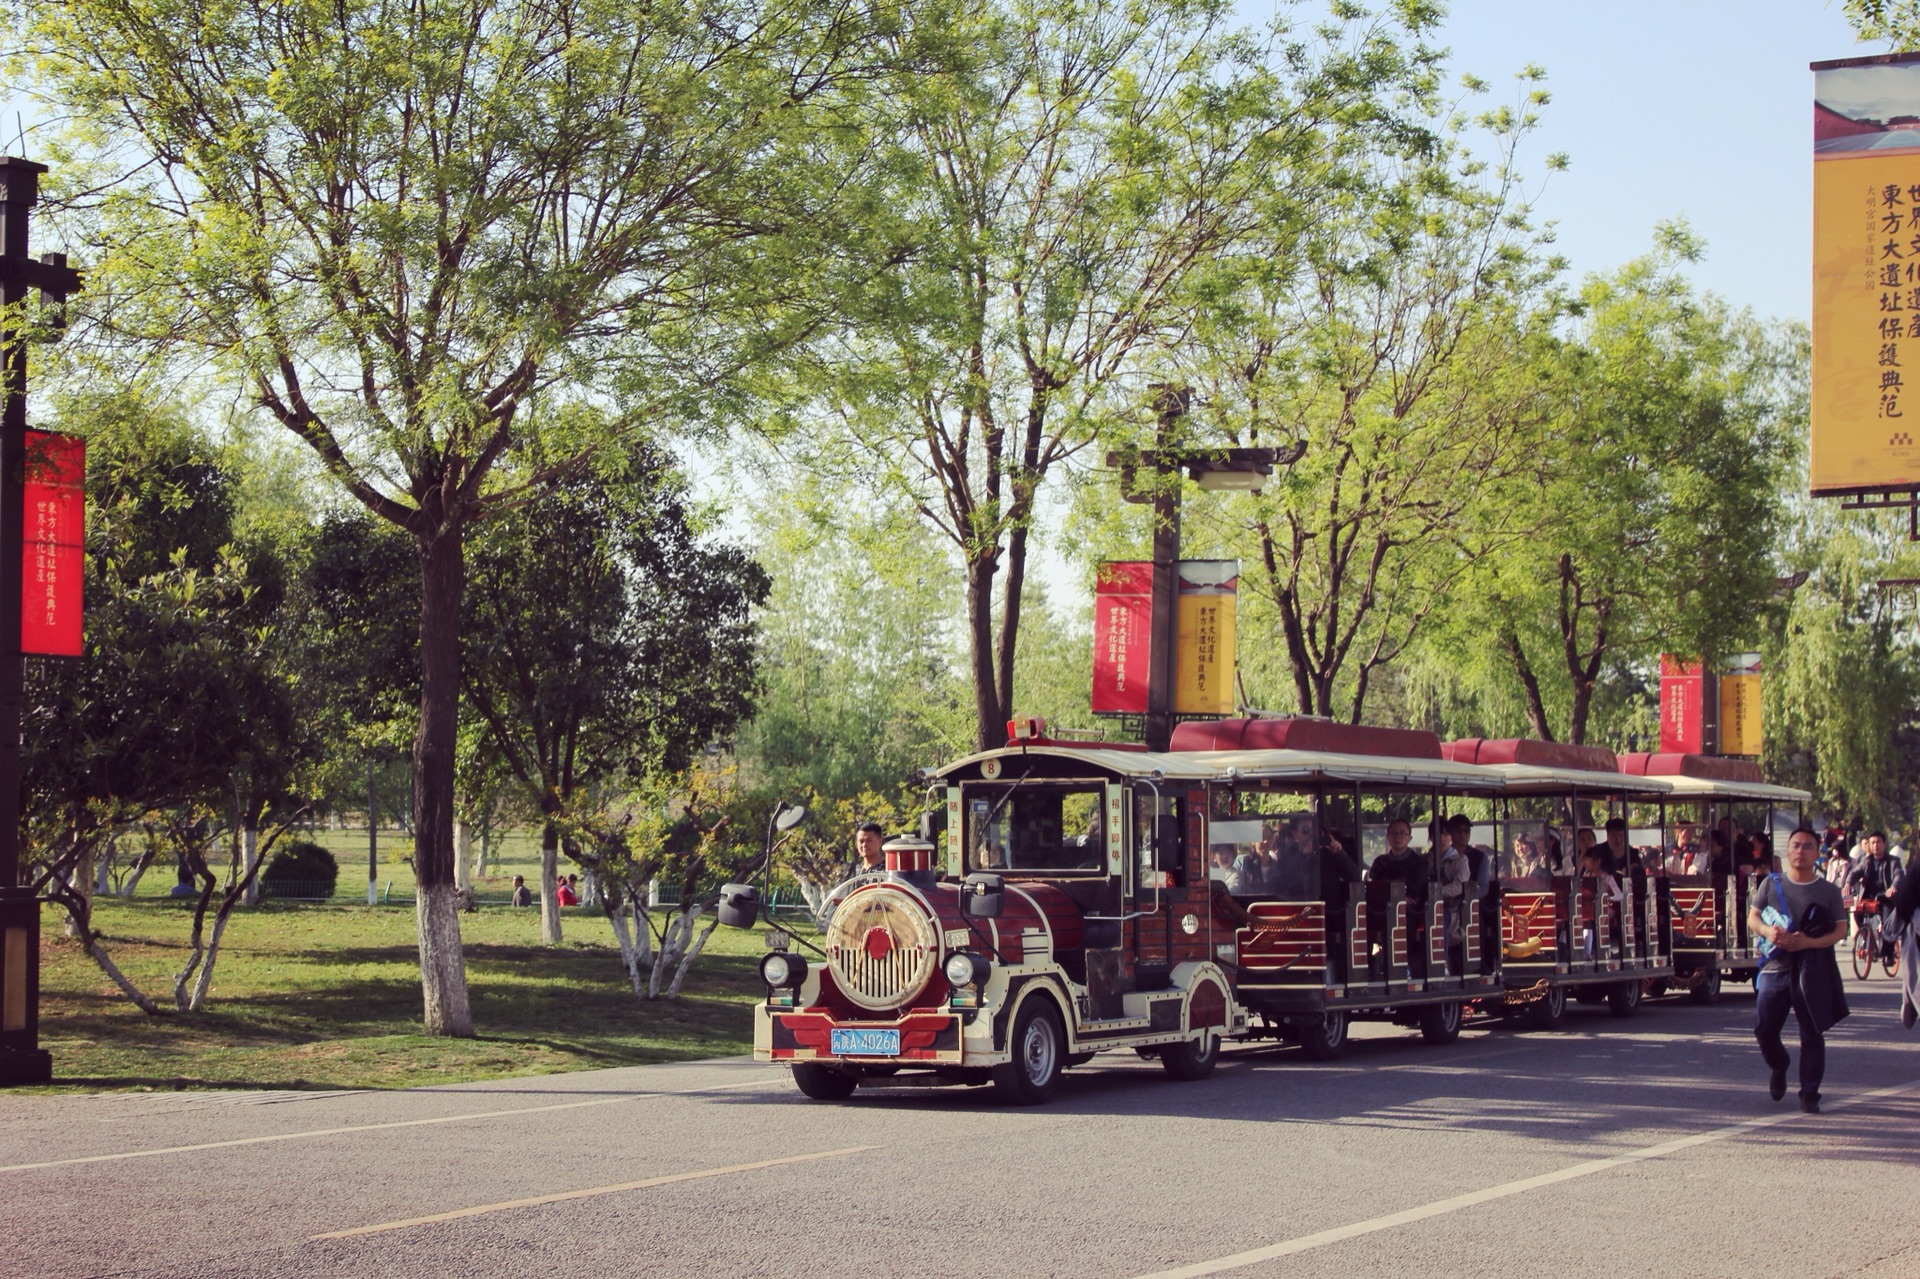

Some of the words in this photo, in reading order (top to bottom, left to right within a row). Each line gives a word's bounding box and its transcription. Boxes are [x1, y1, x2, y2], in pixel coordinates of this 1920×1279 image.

[987, 763, 995, 775] 8
[949, 801, 959, 863] 随上随下
[1111, 798, 1120, 862] 招手即停
